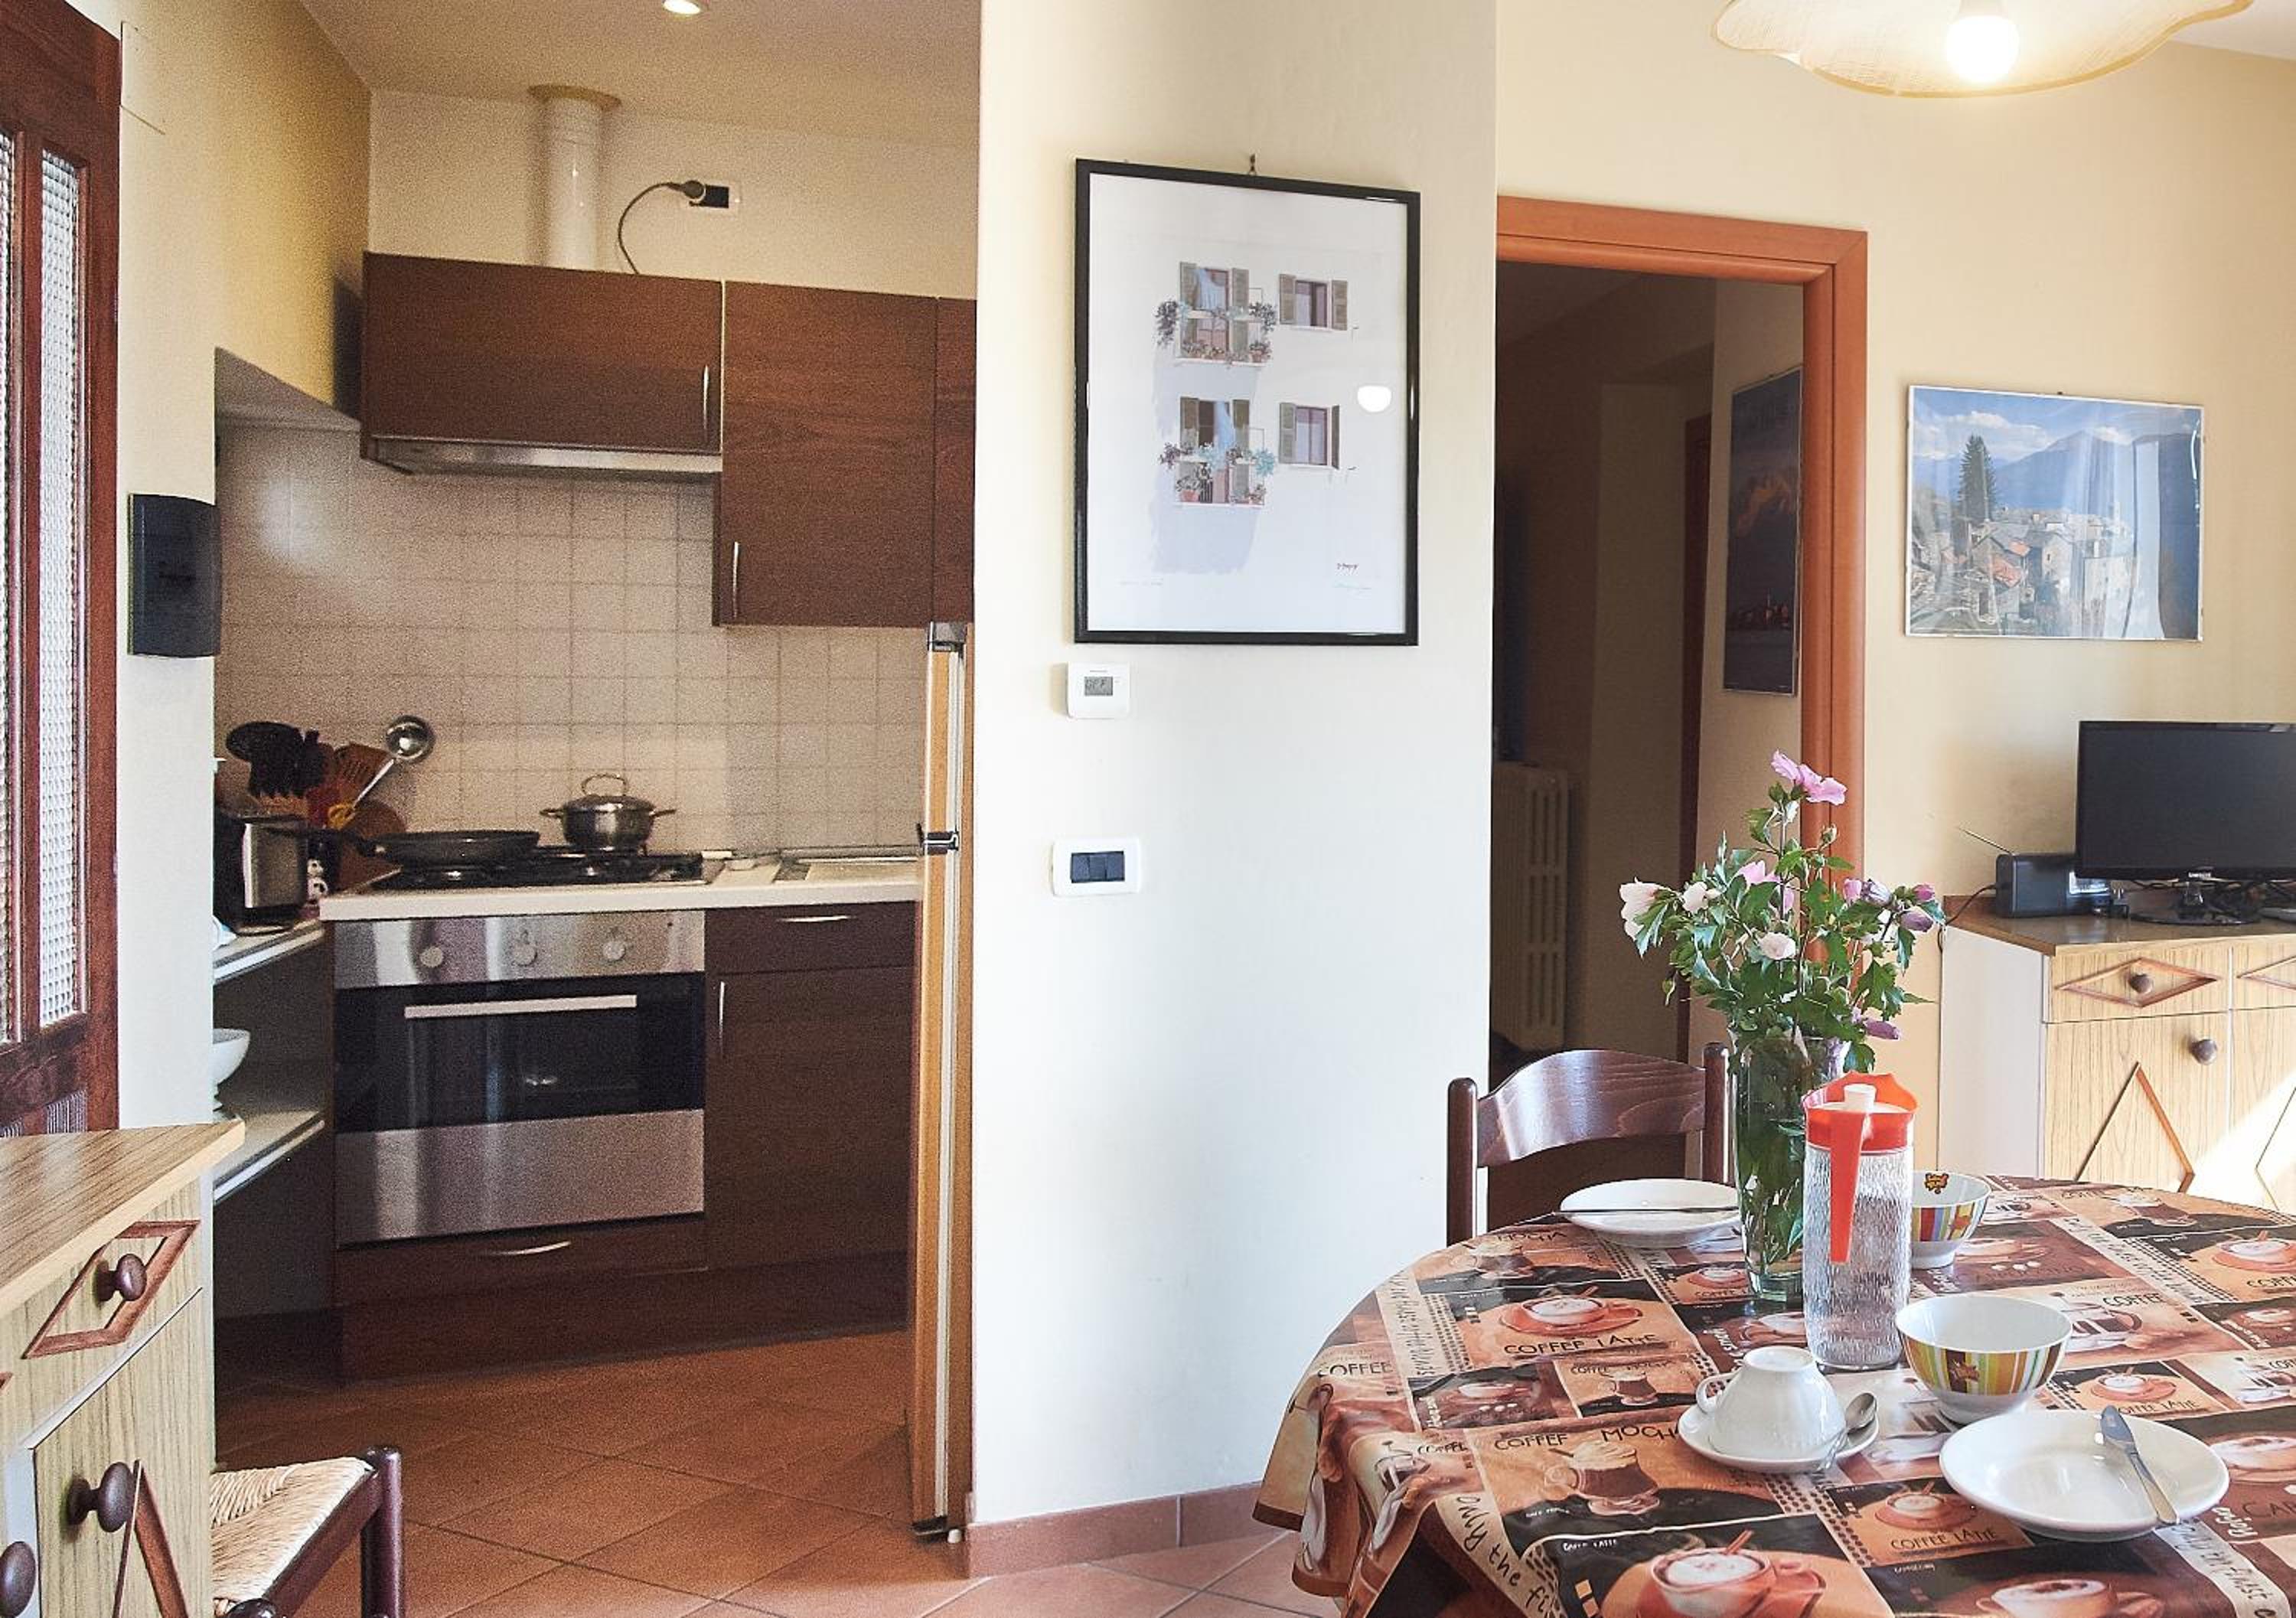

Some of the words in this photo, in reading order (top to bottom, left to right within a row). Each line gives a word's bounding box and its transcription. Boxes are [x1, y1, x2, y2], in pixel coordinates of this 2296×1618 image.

[1504, 1339, 1586, 1355] COFFEE
[1316, 1359, 1394, 1378] COFFEE
[1494, 1432, 1569, 1451] COFFEE
[1890, 1533, 1948, 1549] COFFEE
[1489, 1542, 1521, 1587] the
